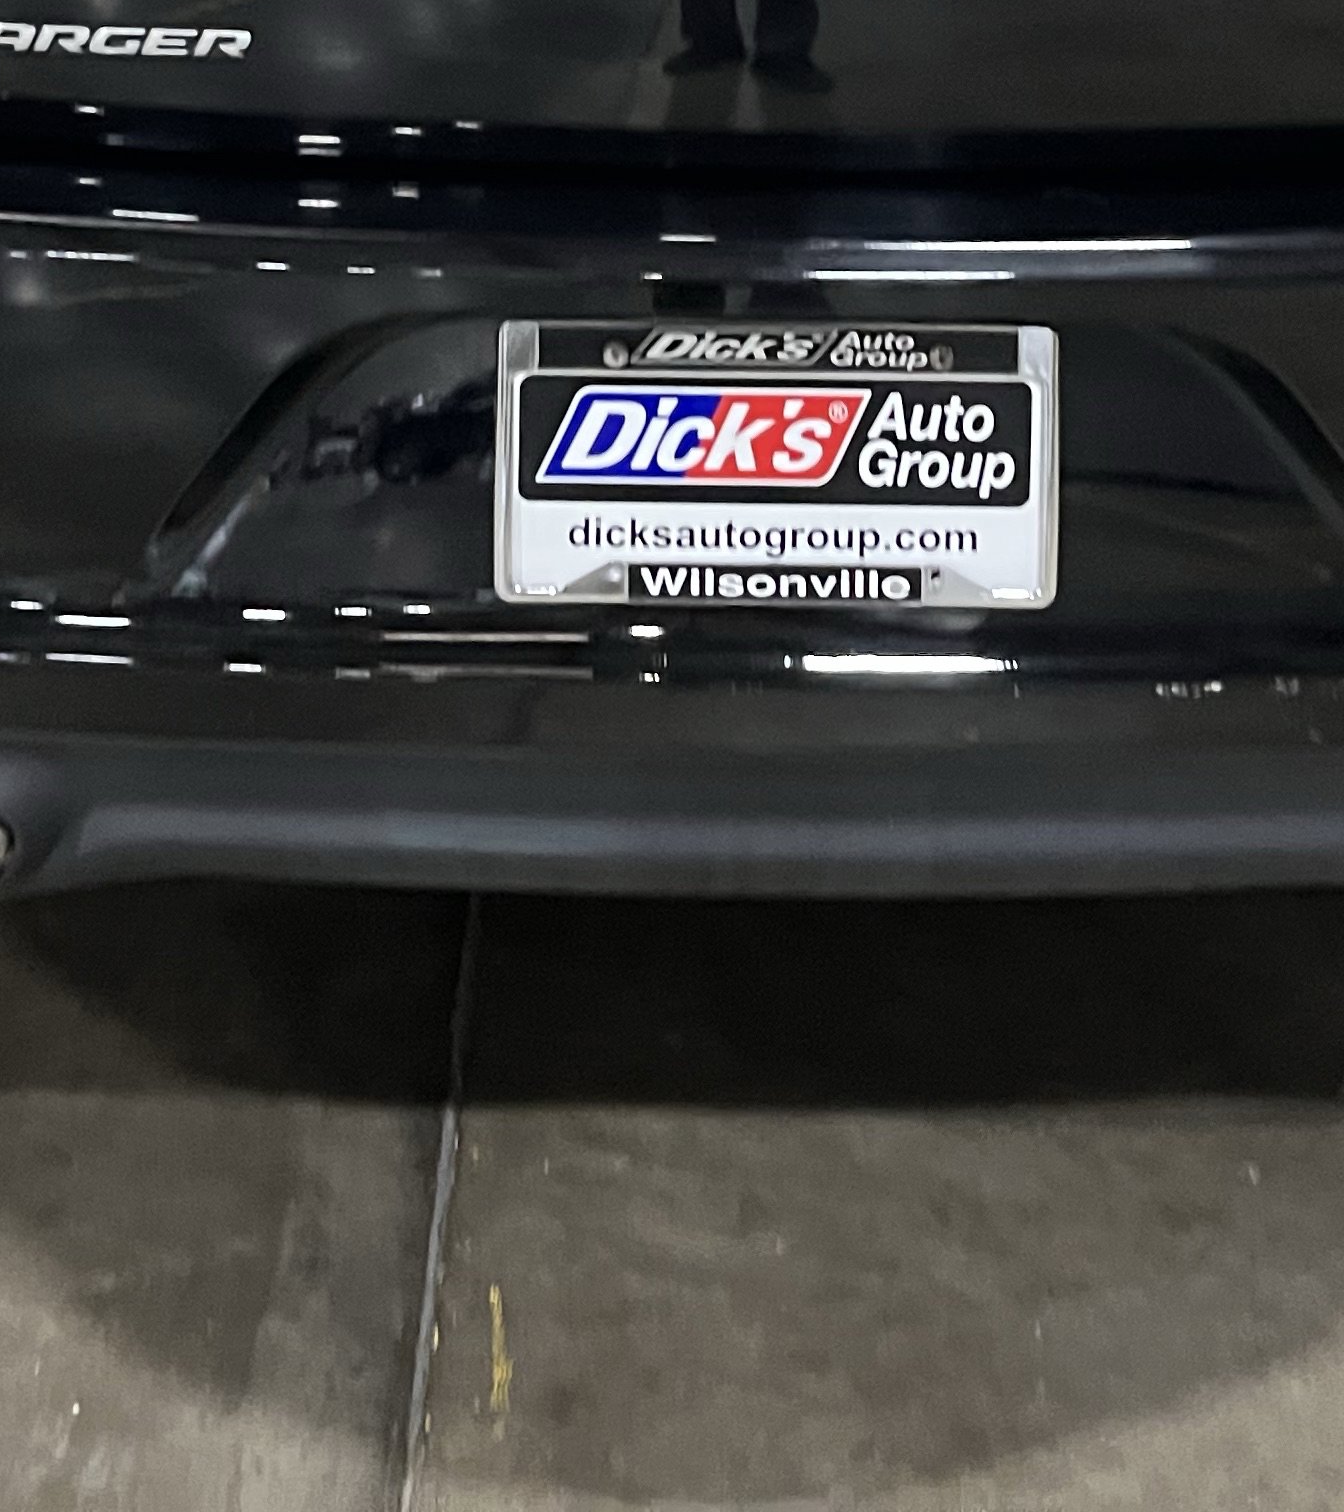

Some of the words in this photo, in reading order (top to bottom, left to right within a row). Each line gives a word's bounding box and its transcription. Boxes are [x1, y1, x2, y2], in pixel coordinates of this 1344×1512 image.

[646, 330, 814, 362] Dick's
[829, 346, 929, 371] Group
[838, 330, 915, 350] Auto
[561, 396, 832, 473] Dick's
[867, 392, 994, 443] Auto
[859, 439, 1015, 499] Group
[567, 517, 979, 558] dicksautogroup.com
[639, 566, 912, 600] Wilsonville
